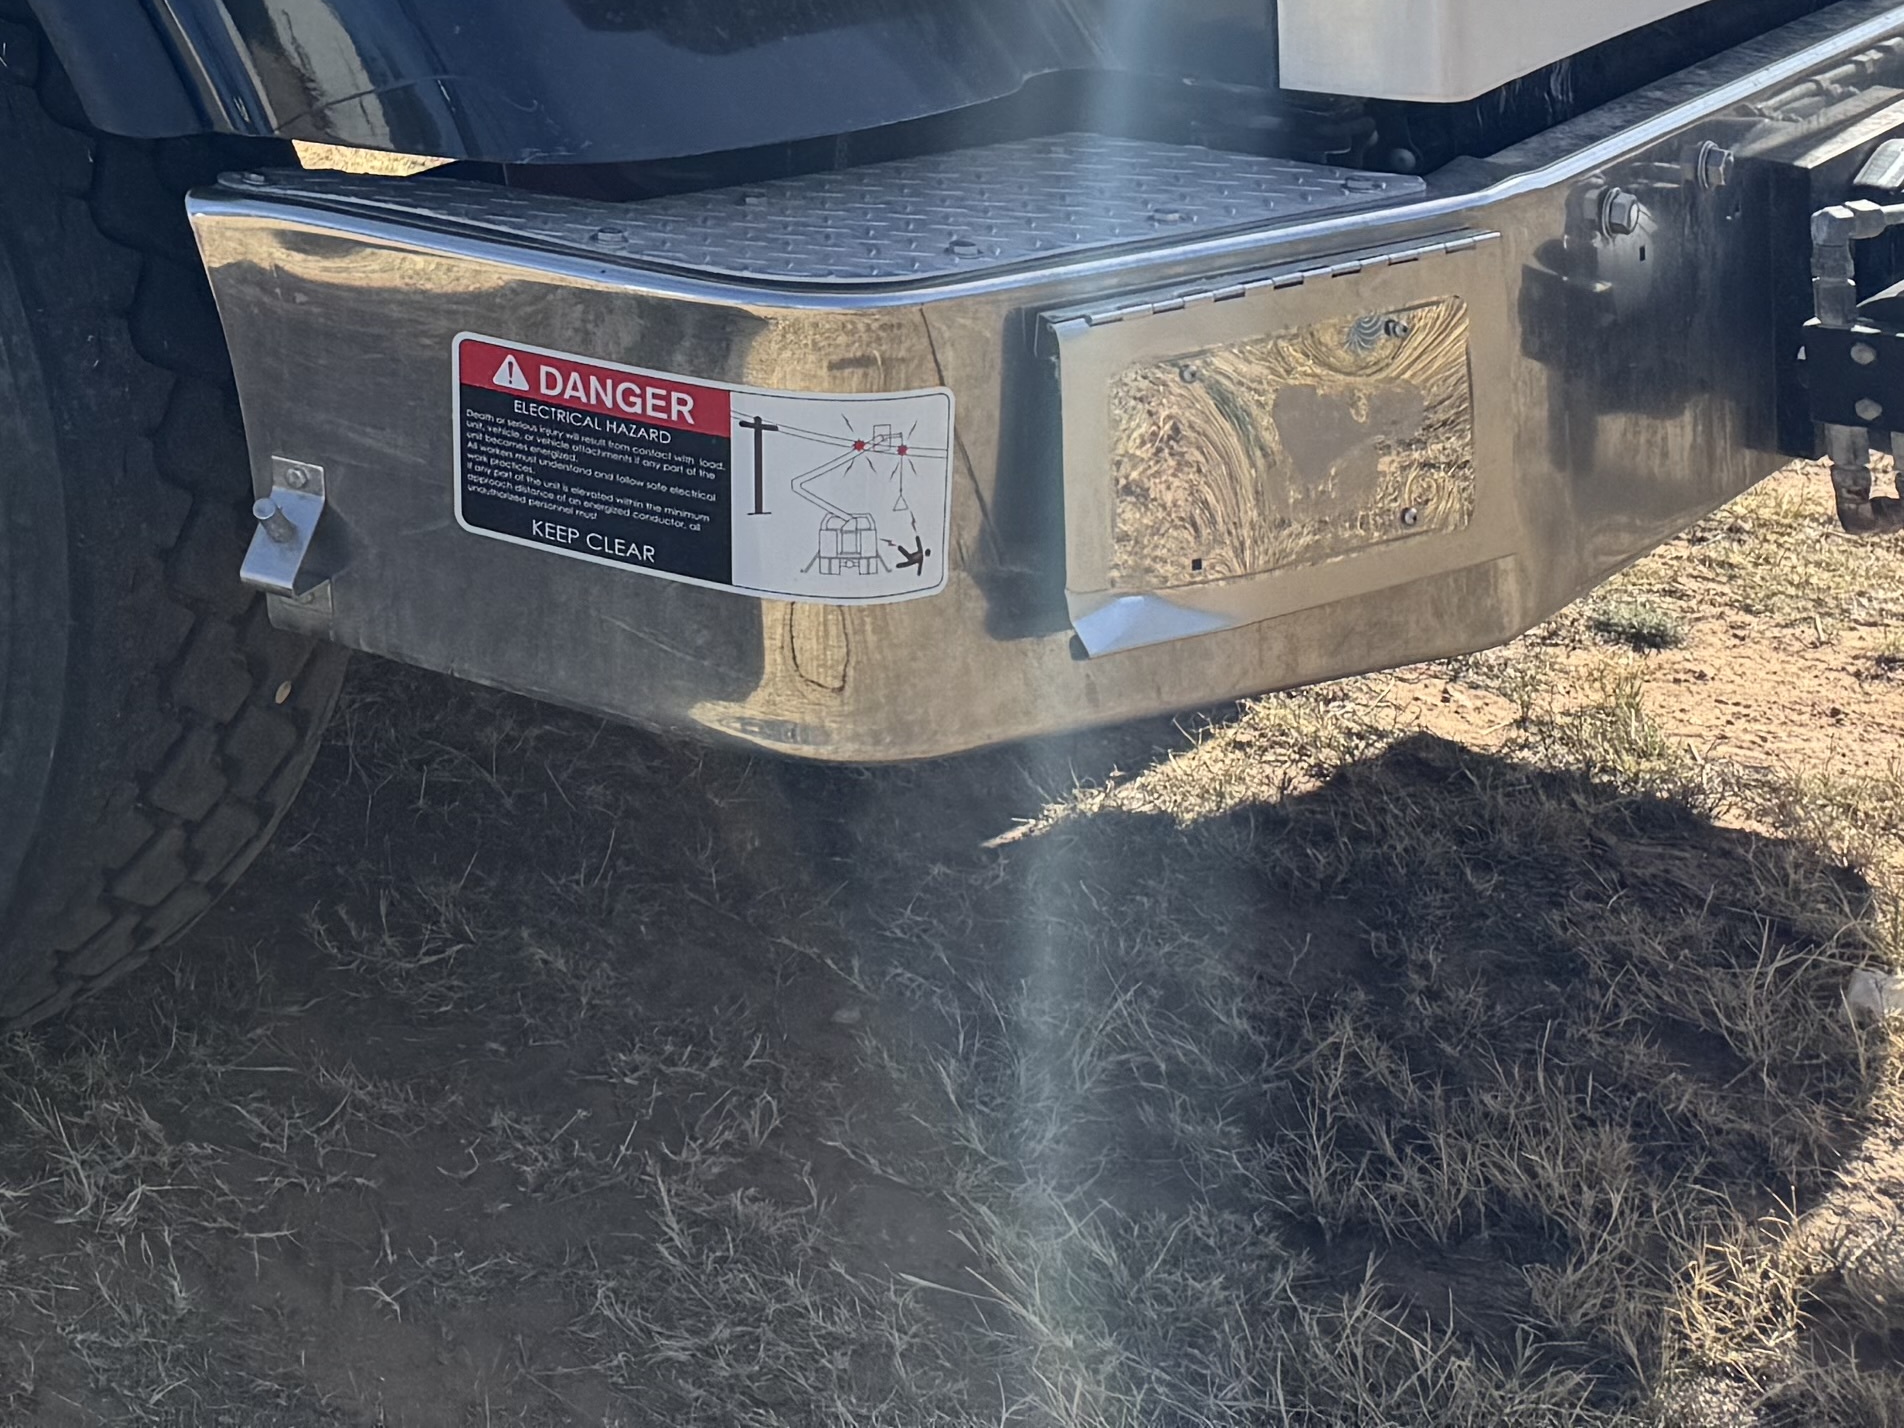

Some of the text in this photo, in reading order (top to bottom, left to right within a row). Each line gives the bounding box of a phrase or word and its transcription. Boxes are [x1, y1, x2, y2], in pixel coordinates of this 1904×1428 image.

[539, 364, 695, 425] DANGER
[514, 399, 672, 444] ELECTRICAL HAZARD
[632, 445, 672, 461] contact
[674, 454, 695, 465] with
[663, 463, 684, 474] part
[699, 468, 716, 480] the
[538, 458, 593, 477] understand
[594, 470, 613, 481] and
[669, 486, 717, 502] electrical
[646, 502, 662, 513] the
[664, 506, 710, 523] minimum
[532, 519, 655, 563] KEEP CLEAR
